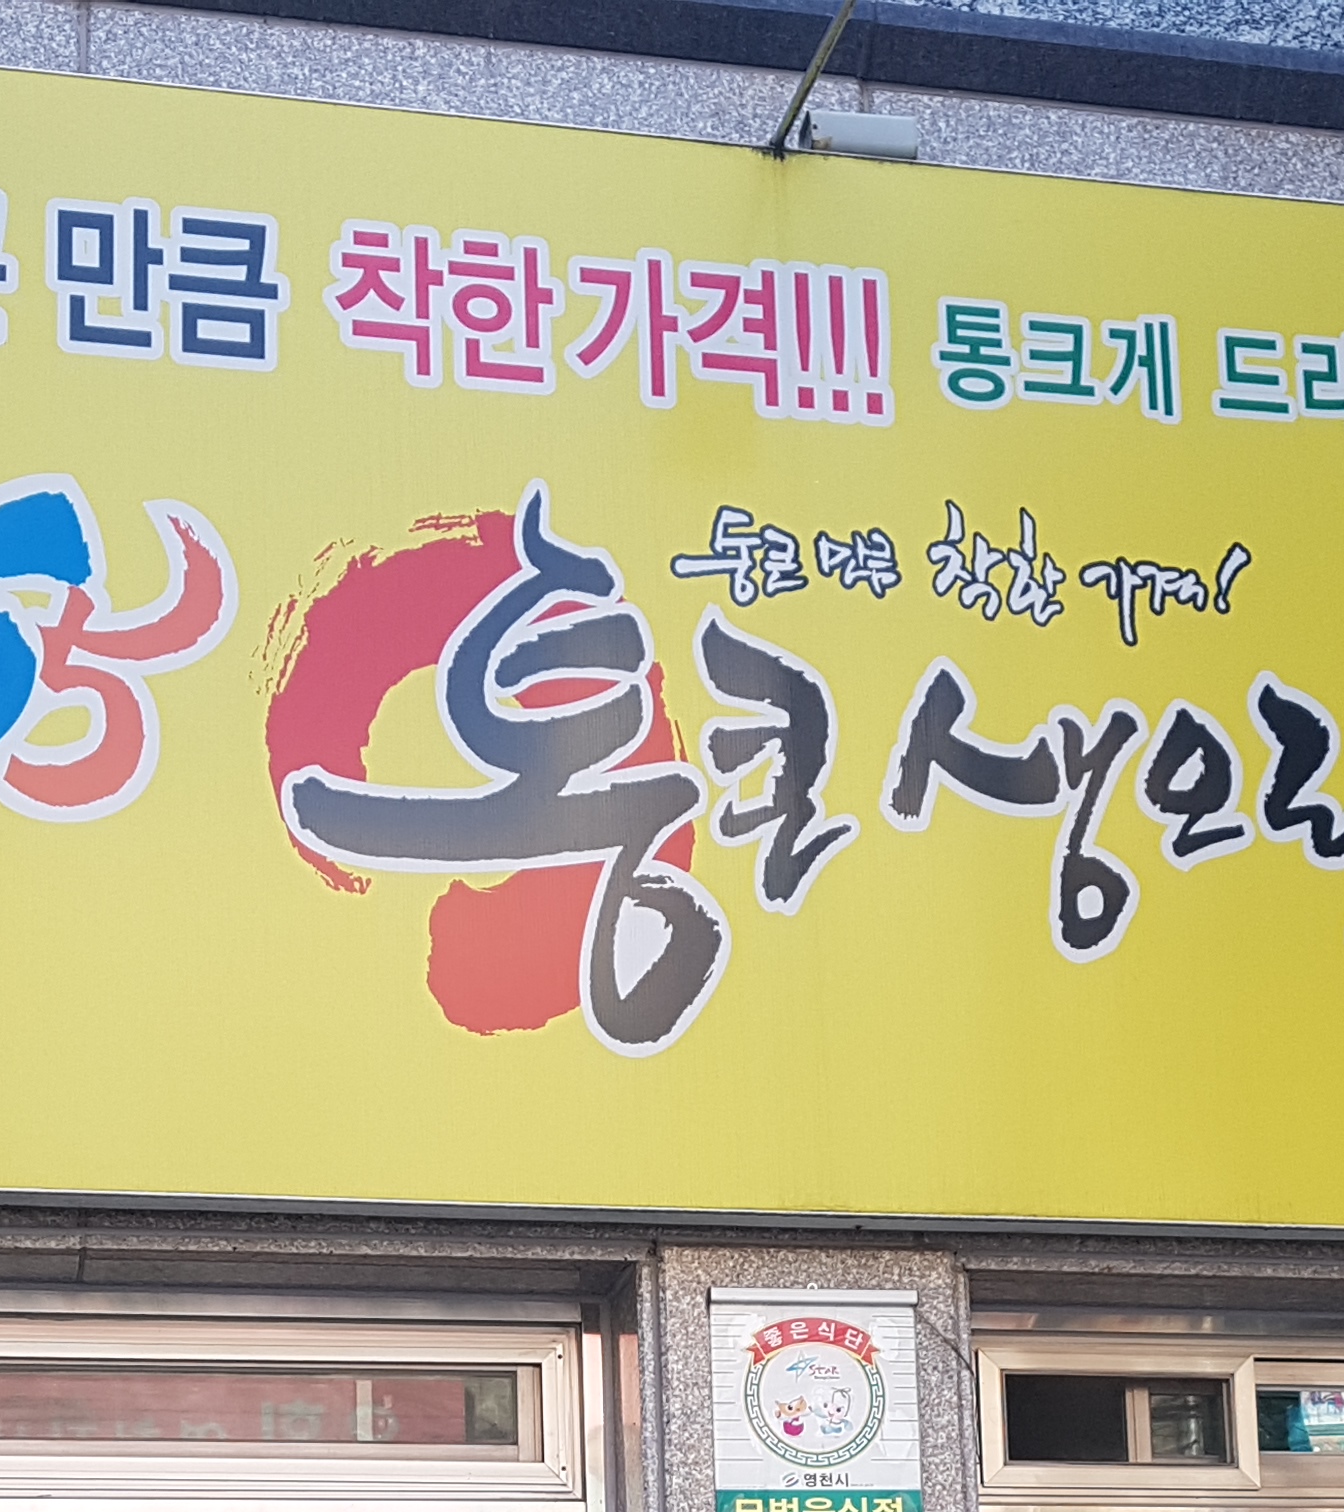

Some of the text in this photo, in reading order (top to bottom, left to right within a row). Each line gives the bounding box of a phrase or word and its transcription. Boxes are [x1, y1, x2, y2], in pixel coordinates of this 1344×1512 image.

[55, 208, 278, 360] 만큼
[335, 229, 553, 383] 착한
[576, 250, 884, 416] 가격!!!
[937, 303, 1175, 417] 통크게
[930, 502, 1064, 627] 착한
[290, 488, 852, 1048] 통큰
[804, 1473, 849, 1487] 영천시
